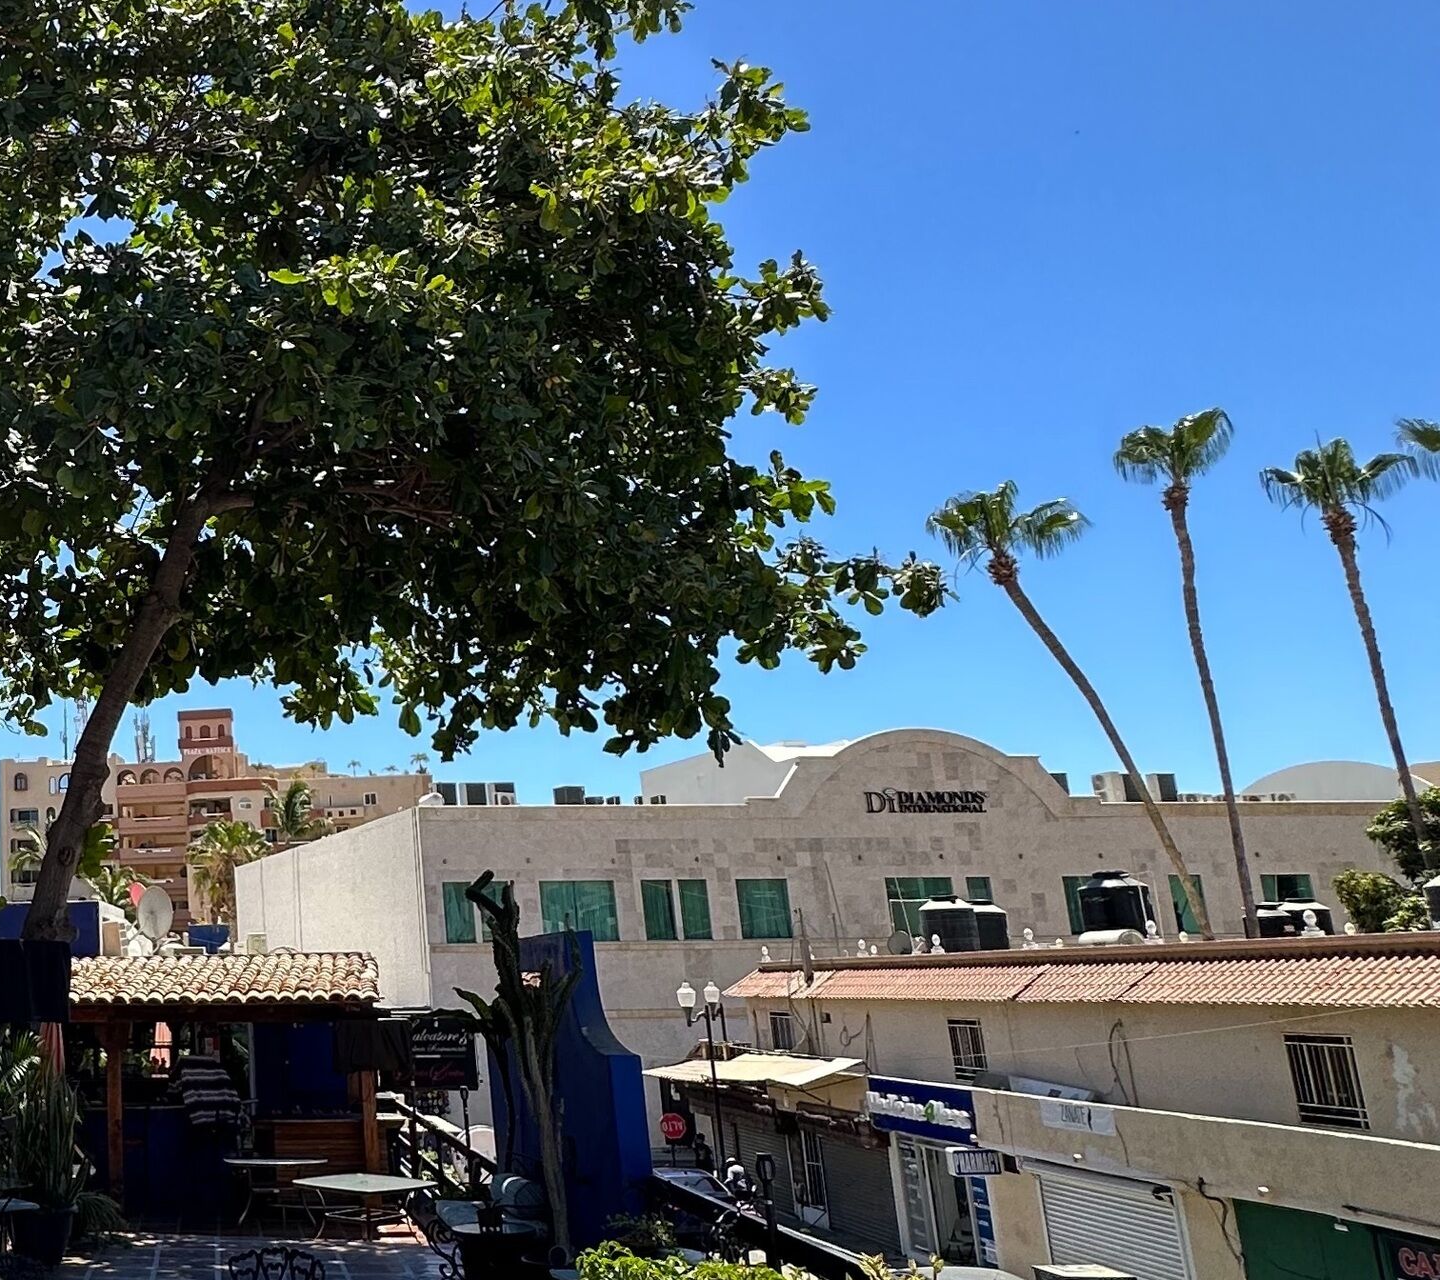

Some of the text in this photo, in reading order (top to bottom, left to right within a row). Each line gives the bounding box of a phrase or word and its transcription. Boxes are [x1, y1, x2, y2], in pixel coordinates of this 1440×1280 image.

[896, 790, 986, 804] DIAMONDS
[899, 804, 987, 813] INTERNATIONAL
[953, 1151, 1000, 1173] PHARMACY
